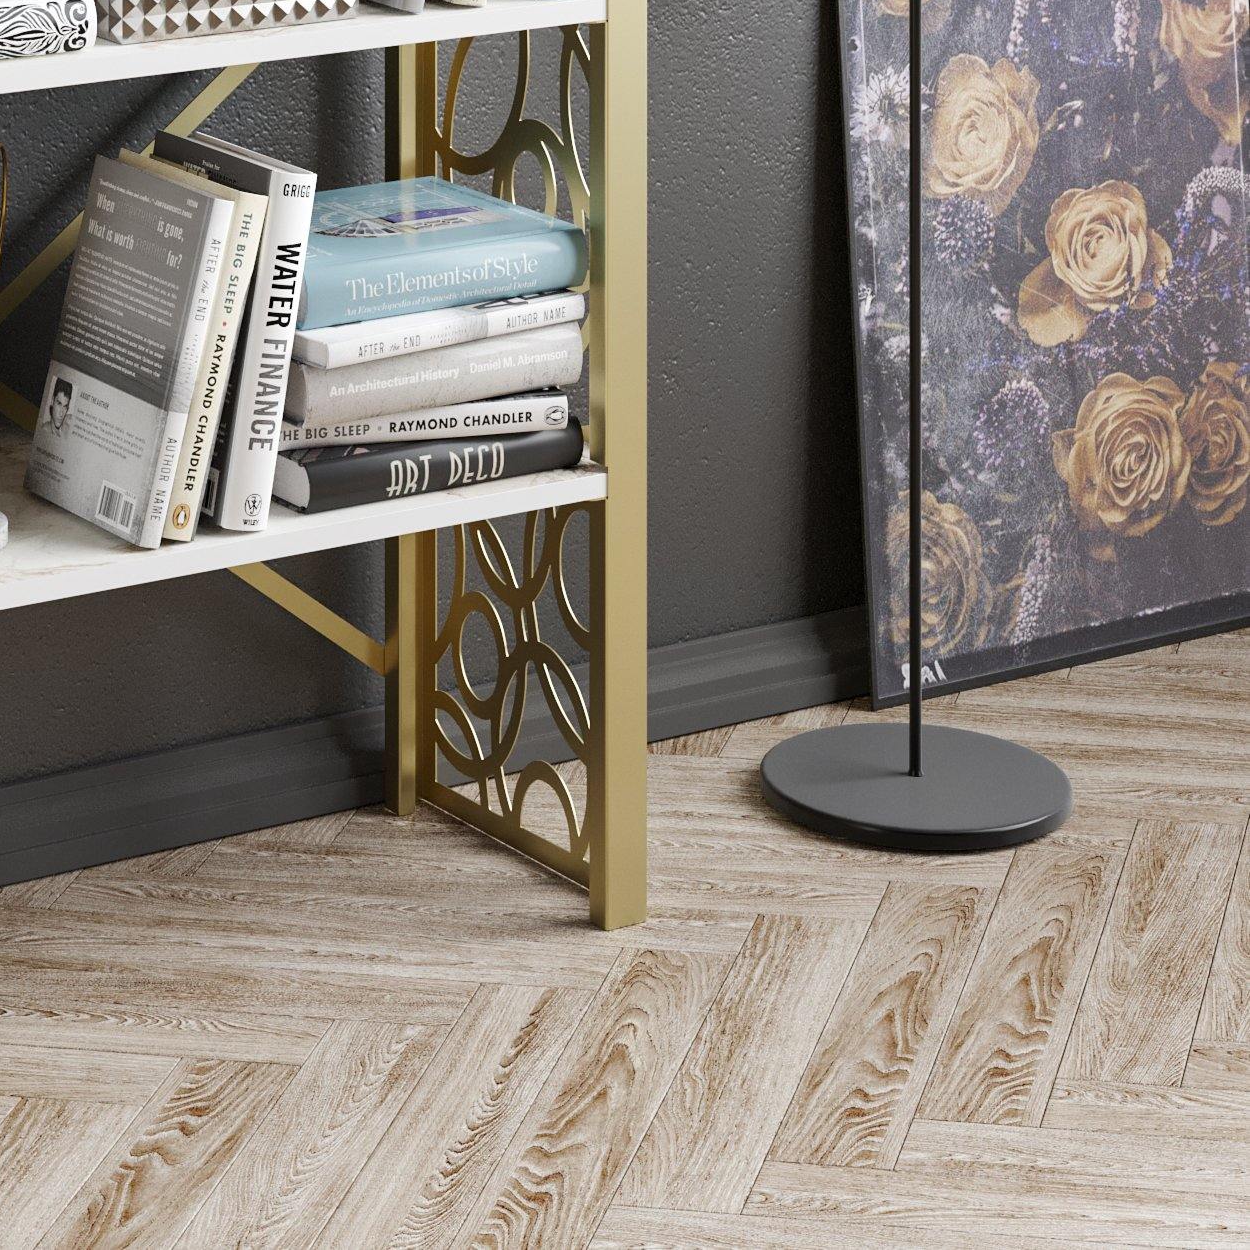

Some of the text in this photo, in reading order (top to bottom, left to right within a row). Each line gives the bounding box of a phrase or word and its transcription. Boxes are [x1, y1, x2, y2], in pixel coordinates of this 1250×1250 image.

[96, 192, 115, 213] When
[283, 183, 311, 198] GRIGG
[88, 218, 106, 239] What
[106, 226, 113, 242] is
[114, 230, 135, 250] worth
[157, 217, 184, 243] is gone,
[237, 214, 252, 240] THE
[166, 250, 183, 269] for?
[204, 239, 222, 273] AFTER
[232, 244, 246, 268] BIG
[346, 253, 539, 301] The Elements of Style
[513, 280, 537, 292] Detail
[194, 297, 209, 322] END
[223, 273, 240, 314] SLEEP
[248, 242, 301, 451] WATER FINANCE
[357, 342, 385, 358] AFTER
[403, 335, 421, 349] END
[506, 313, 539, 329] AUTHOR
[543, 306, 567, 321] NAME
[202, 334, 226, 409] RAYMOND
[329, 349, 568, 397] An Architectural History Daniel M. Abramson
[280, 411, 533, 441] HE BIG SLEEP RAYMOND CHANDLER
[158, 437, 177, 482] AUTHOR
[183, 415, 208, 492] CHANDLER
[386, 441, 505, 498] ART DECO
[150, 489, 167, 521] NAME
[242, 518, 260, 526] WILEY
